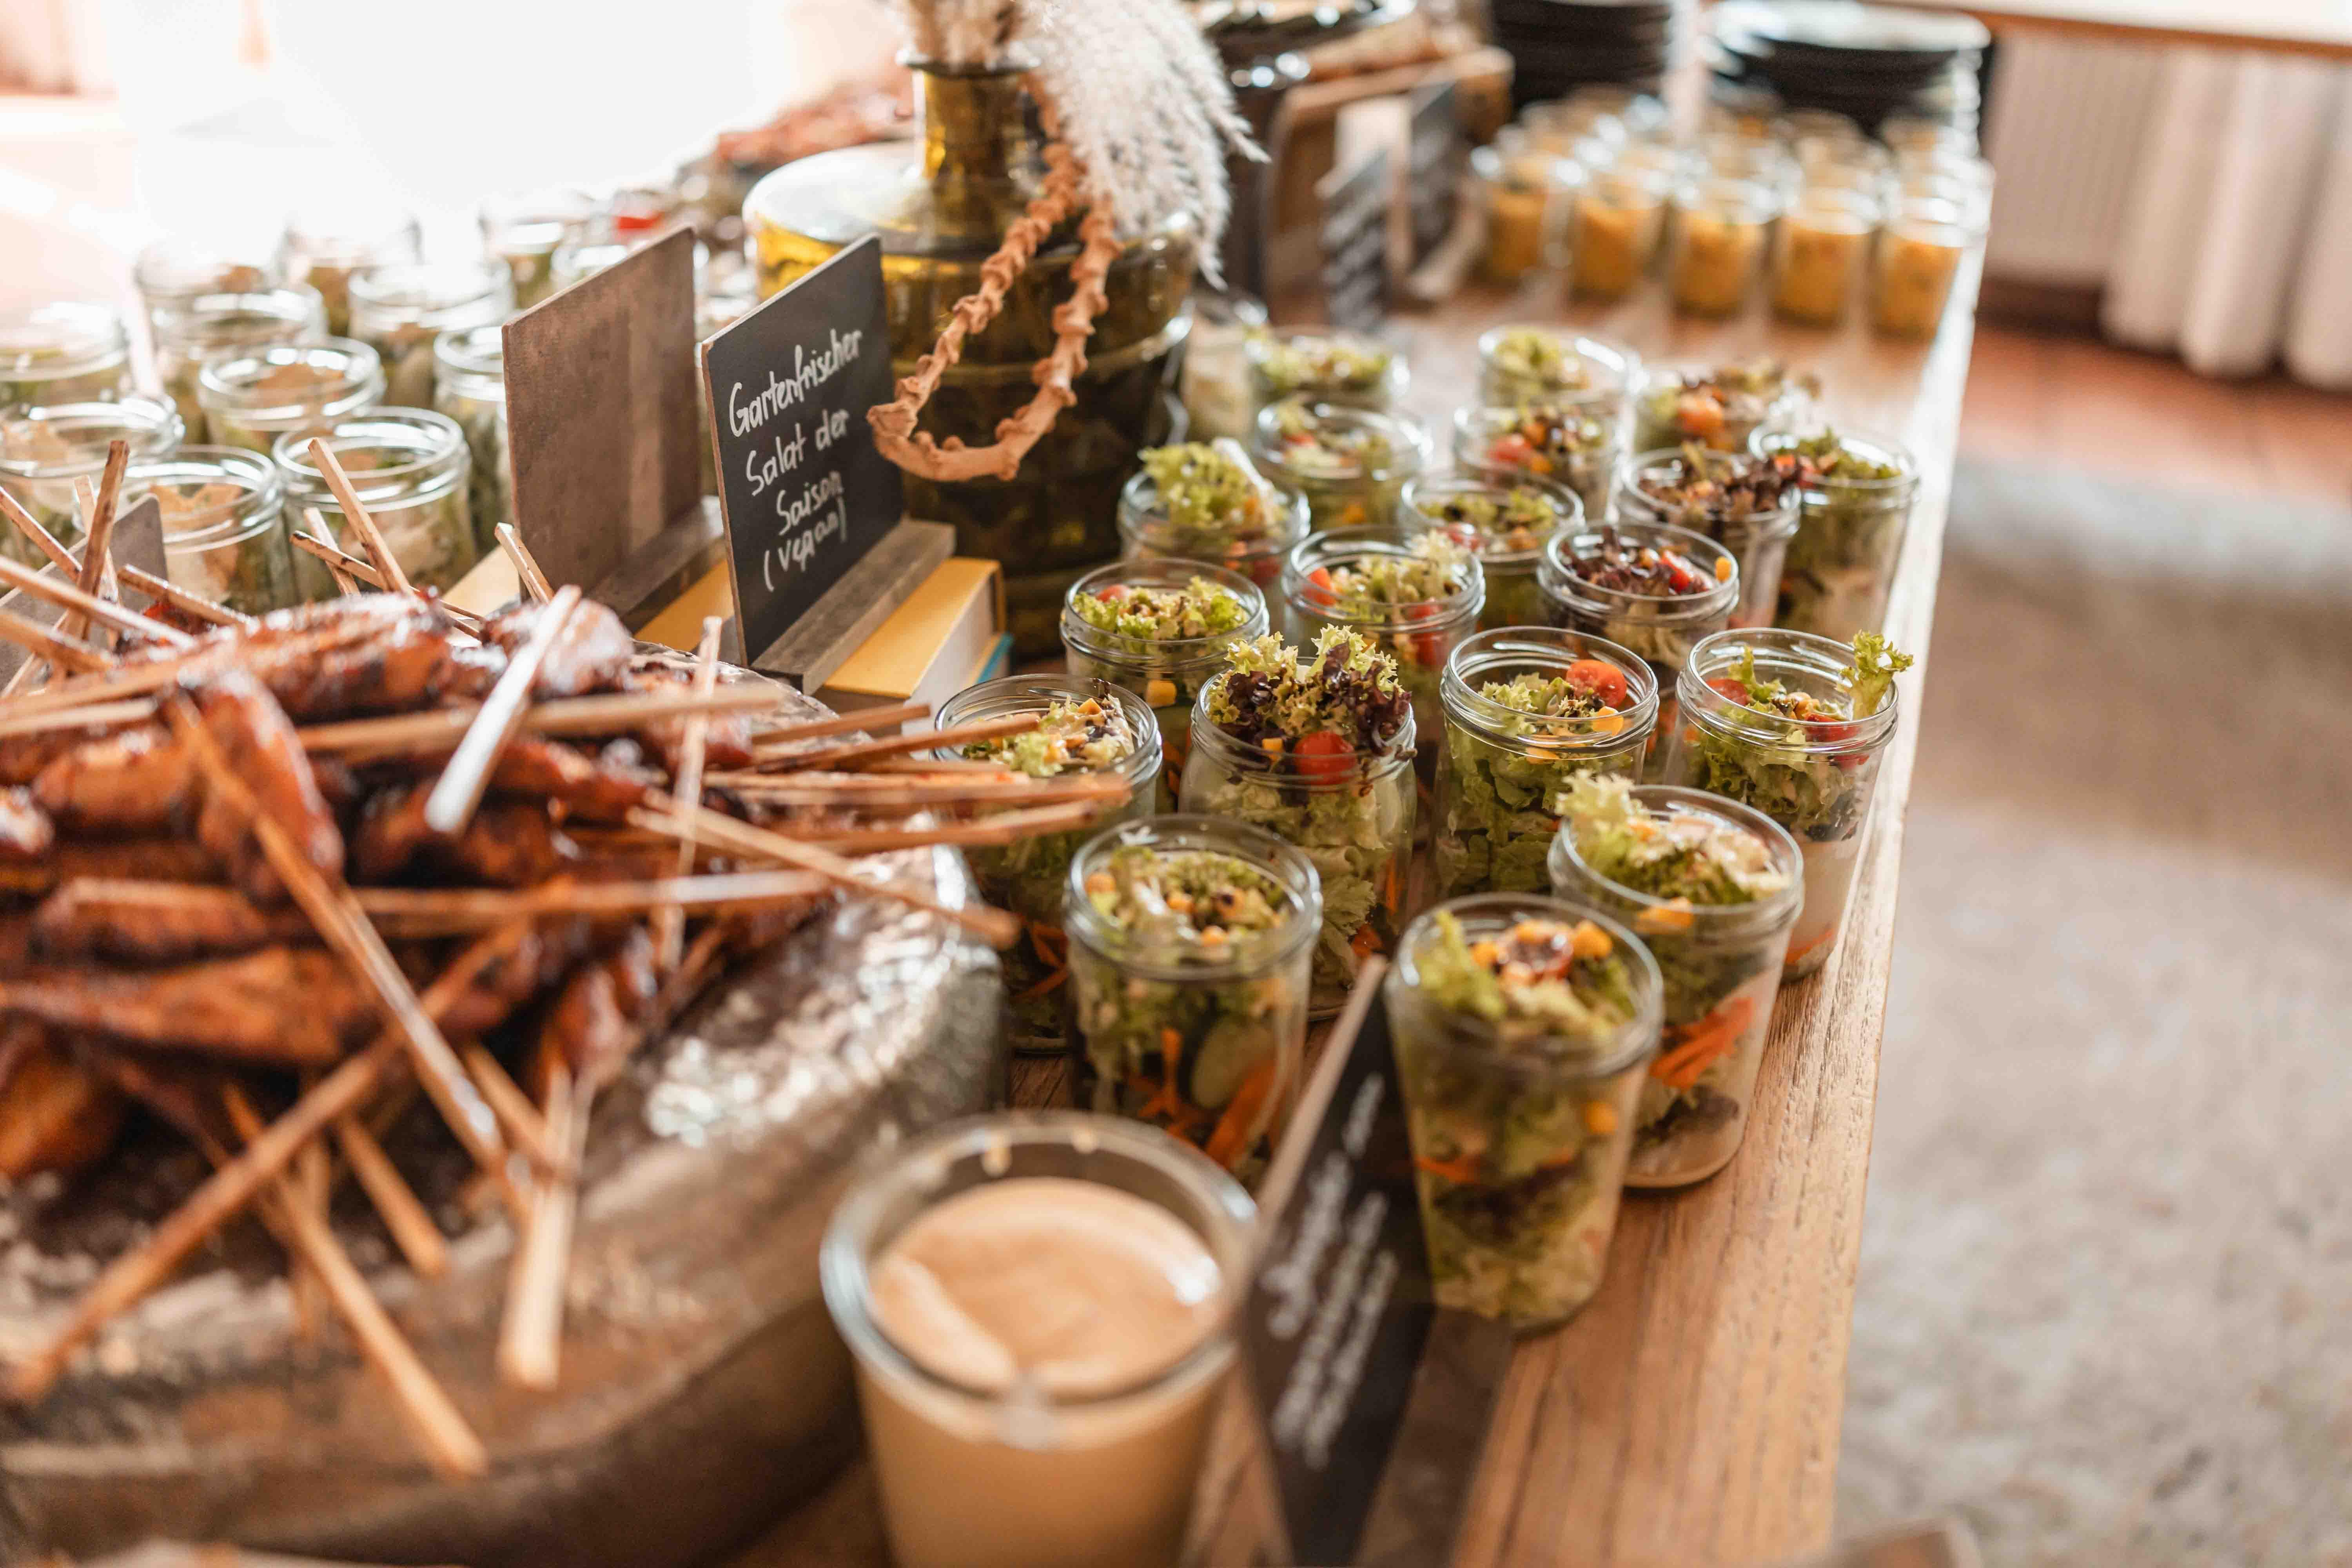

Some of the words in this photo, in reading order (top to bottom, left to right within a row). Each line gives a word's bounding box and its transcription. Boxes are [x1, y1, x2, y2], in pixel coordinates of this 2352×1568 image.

[729, 328, 862, 437] Gartenfrischer
[746, 423, 807, 496] Salat
[815, 408, 850, 452] der
[776, 470, 844, 536] Saison
